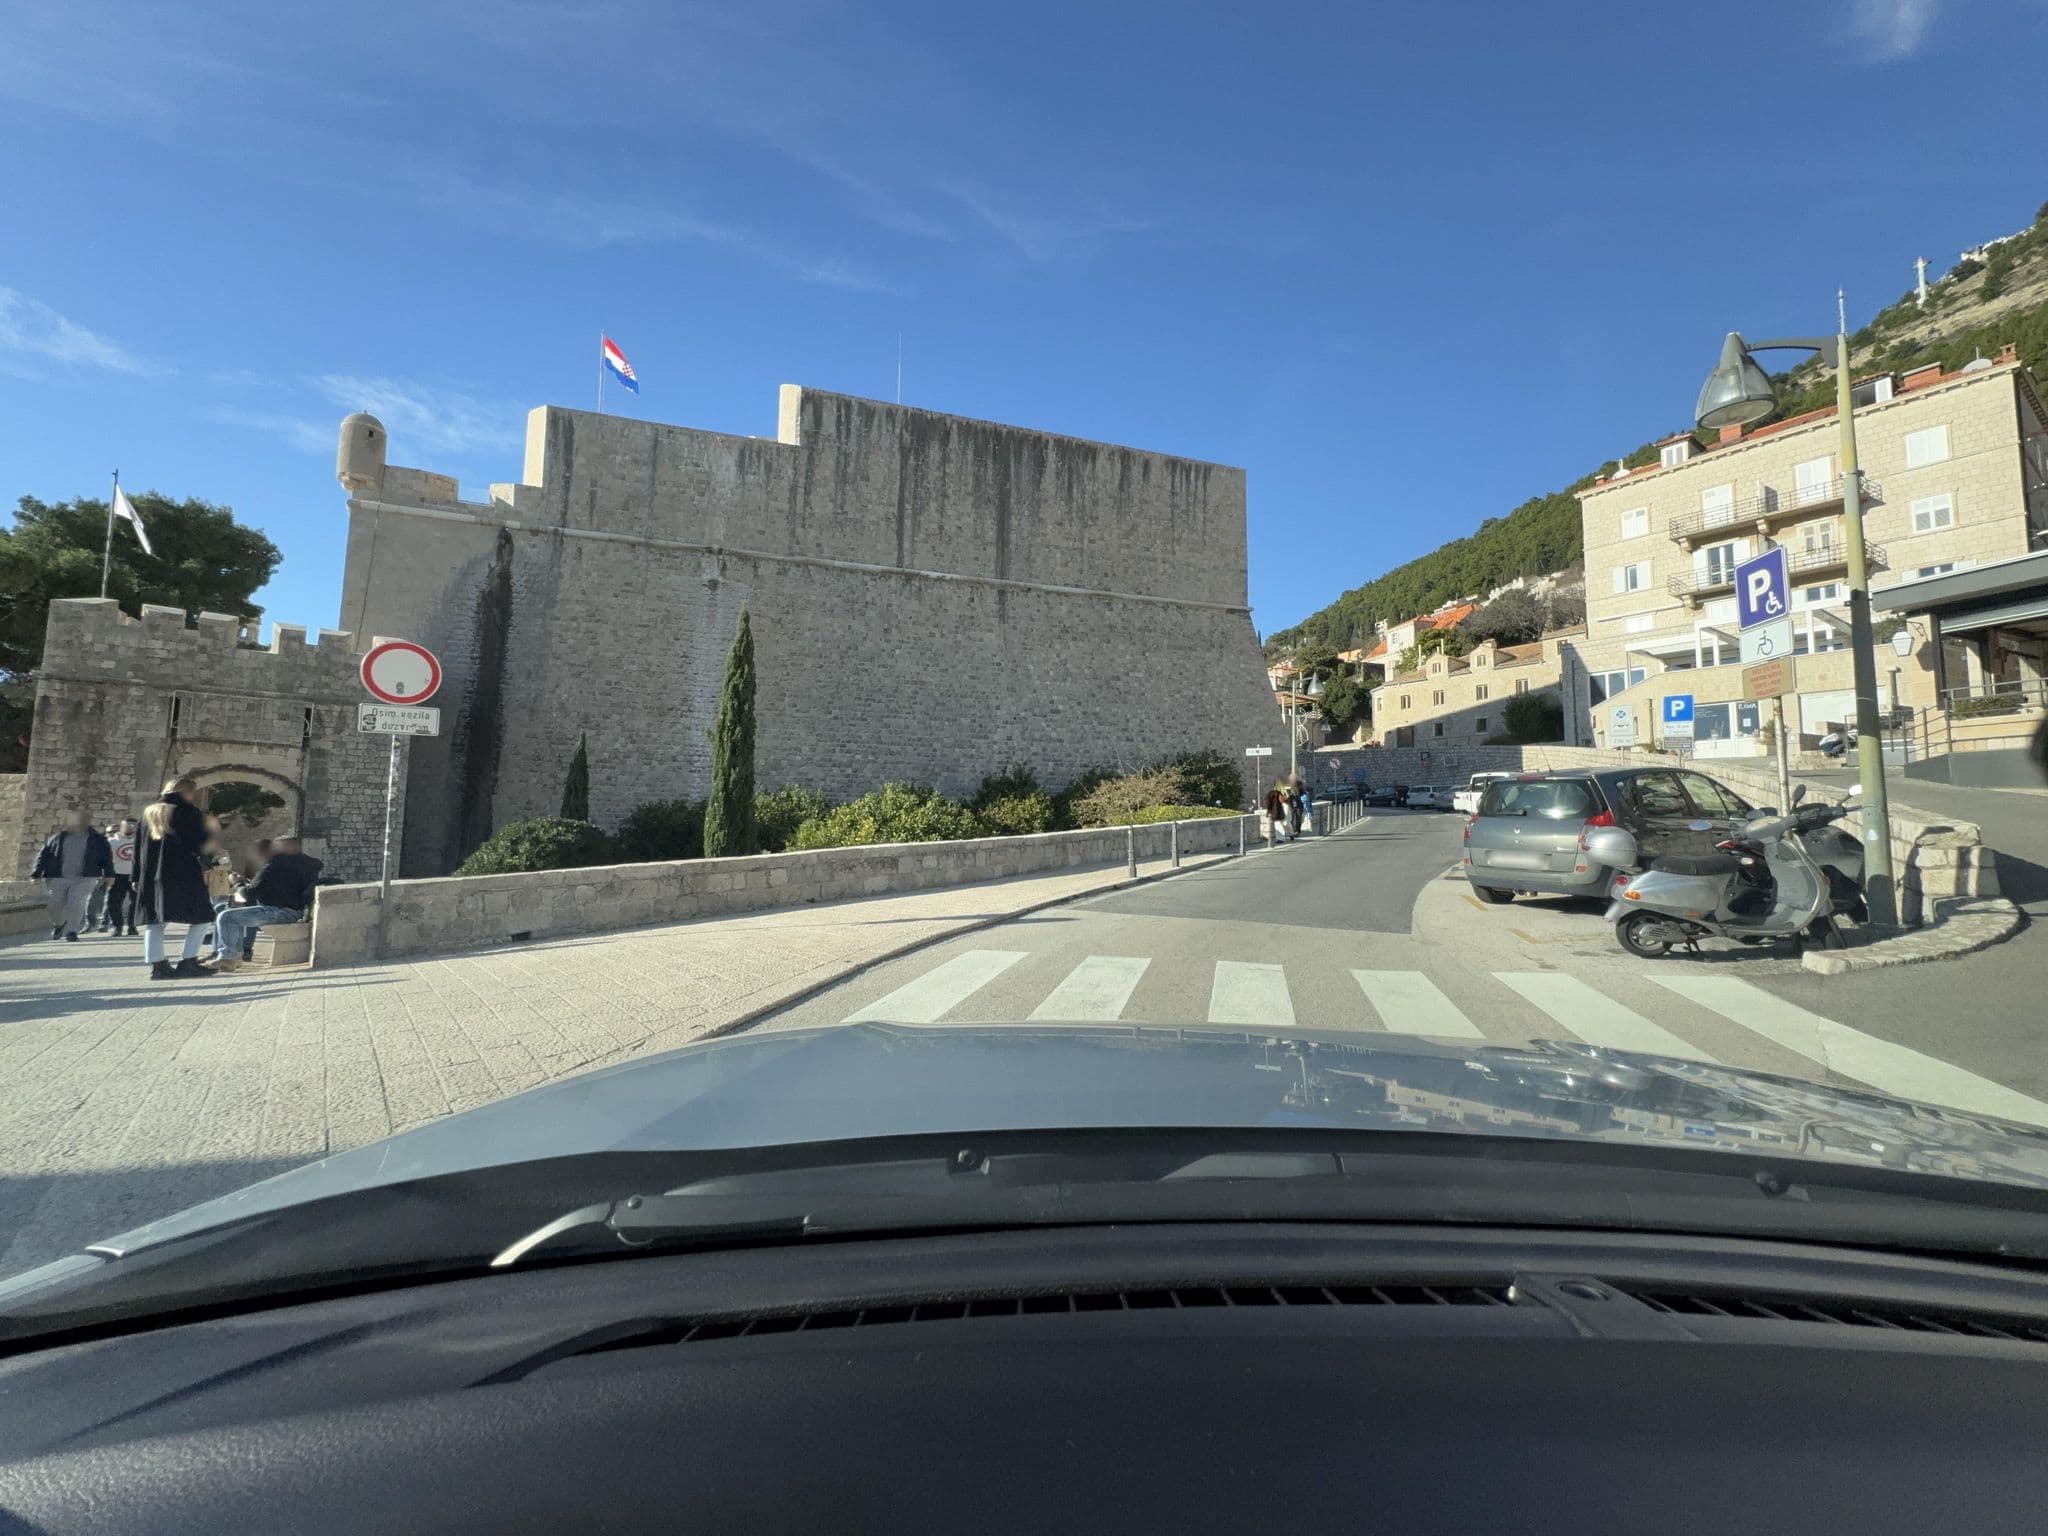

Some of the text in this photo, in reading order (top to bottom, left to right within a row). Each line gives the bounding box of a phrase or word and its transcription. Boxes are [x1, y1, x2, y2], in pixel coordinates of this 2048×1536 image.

[1748, 569, 1771, 613] P
[372, 708, 431, 720] Osim vozila
[1671, 700, 1686, 717] P
